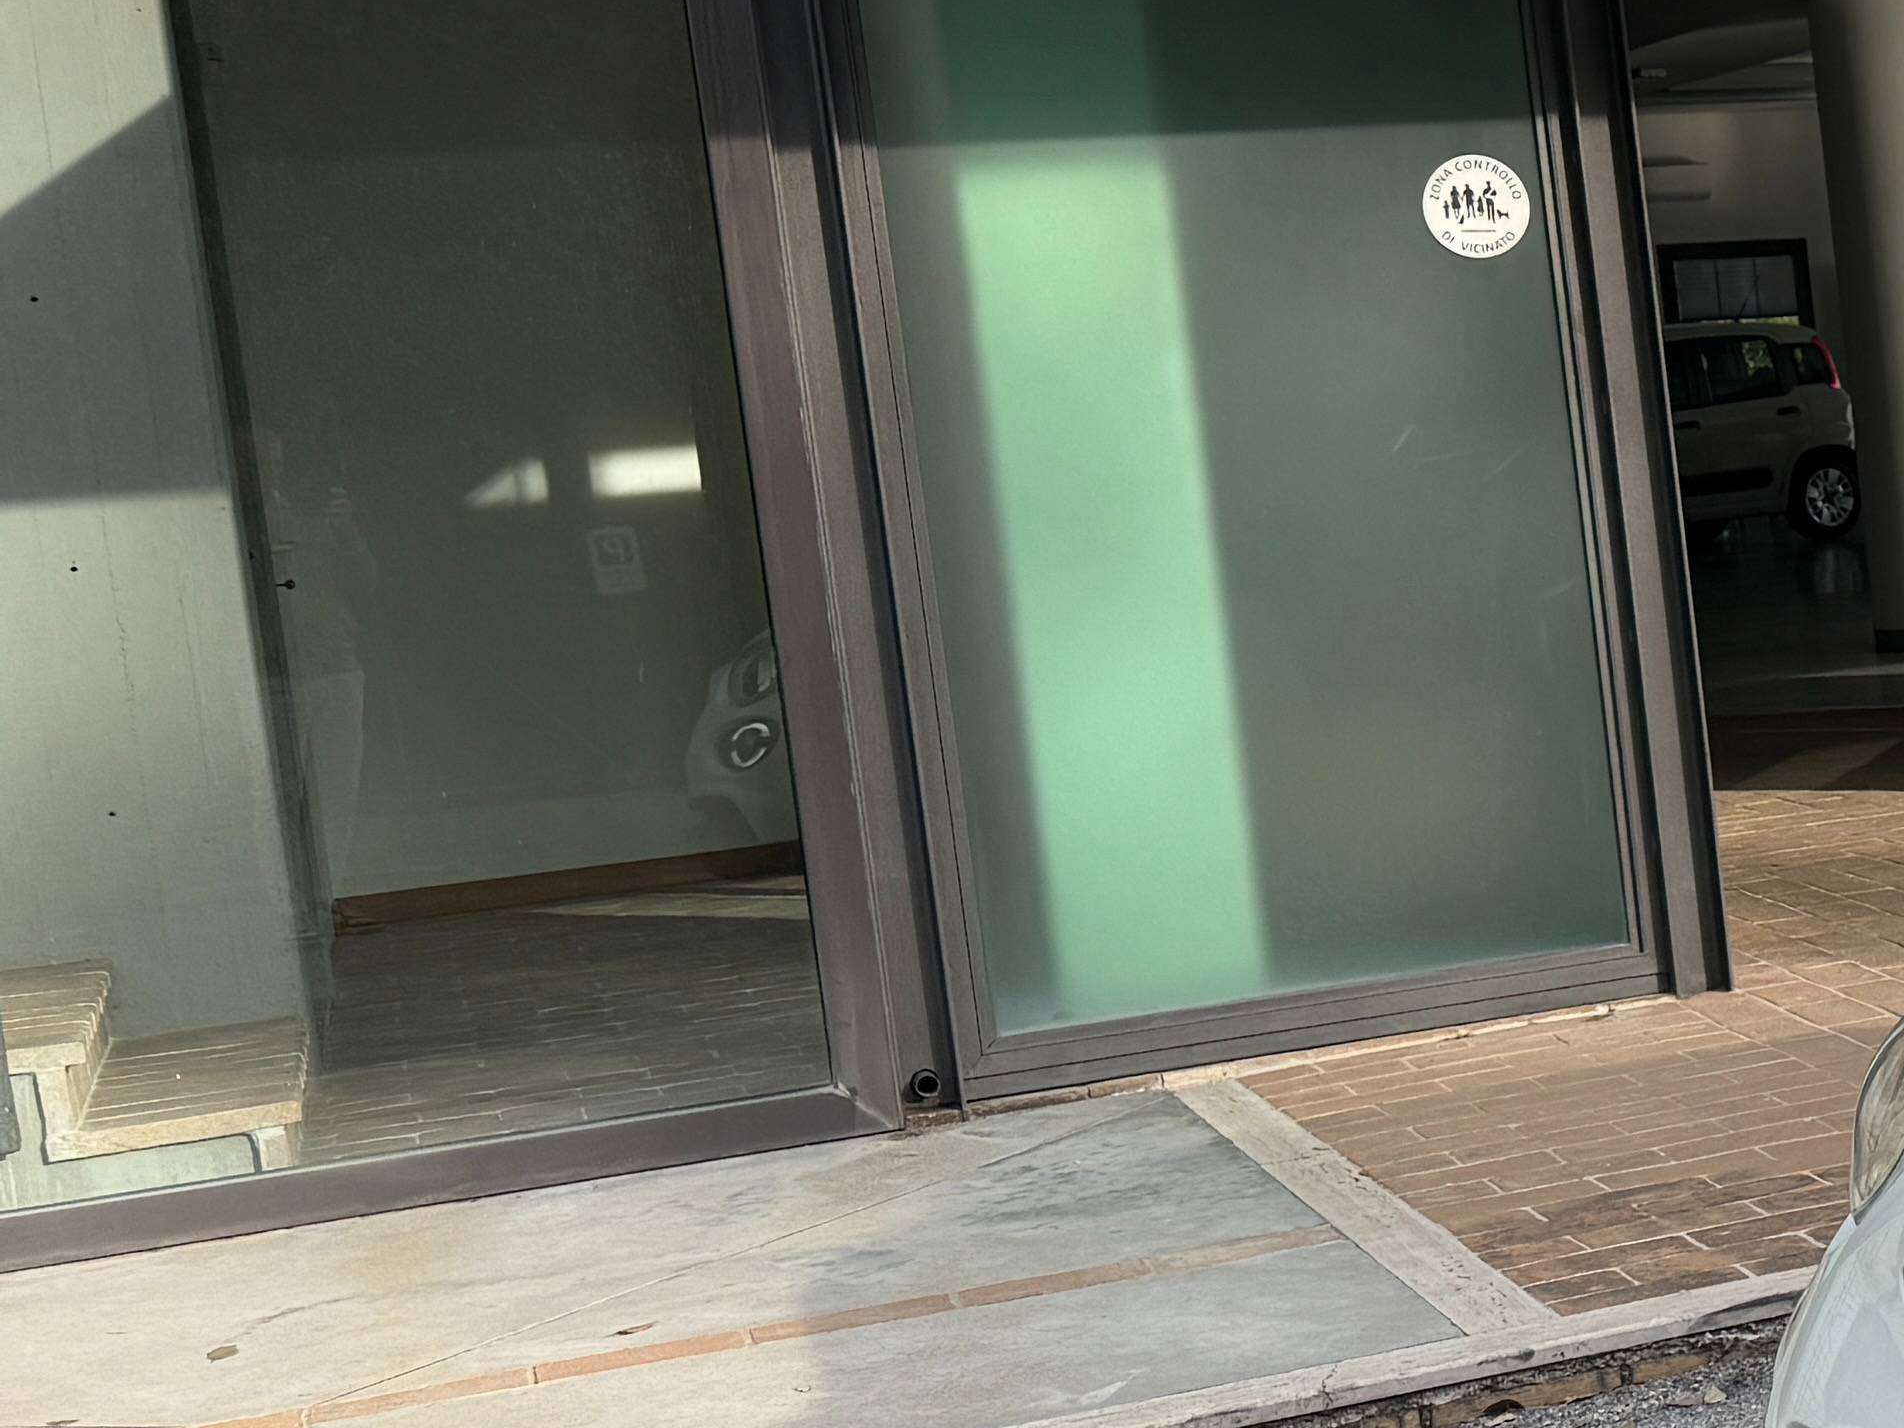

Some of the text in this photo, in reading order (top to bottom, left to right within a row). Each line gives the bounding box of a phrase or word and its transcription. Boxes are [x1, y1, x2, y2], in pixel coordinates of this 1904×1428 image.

[1429, 159, 1522, 200] ZONA CONTROLLO
[1441, 229, 1517, 254] DI VICINATO
